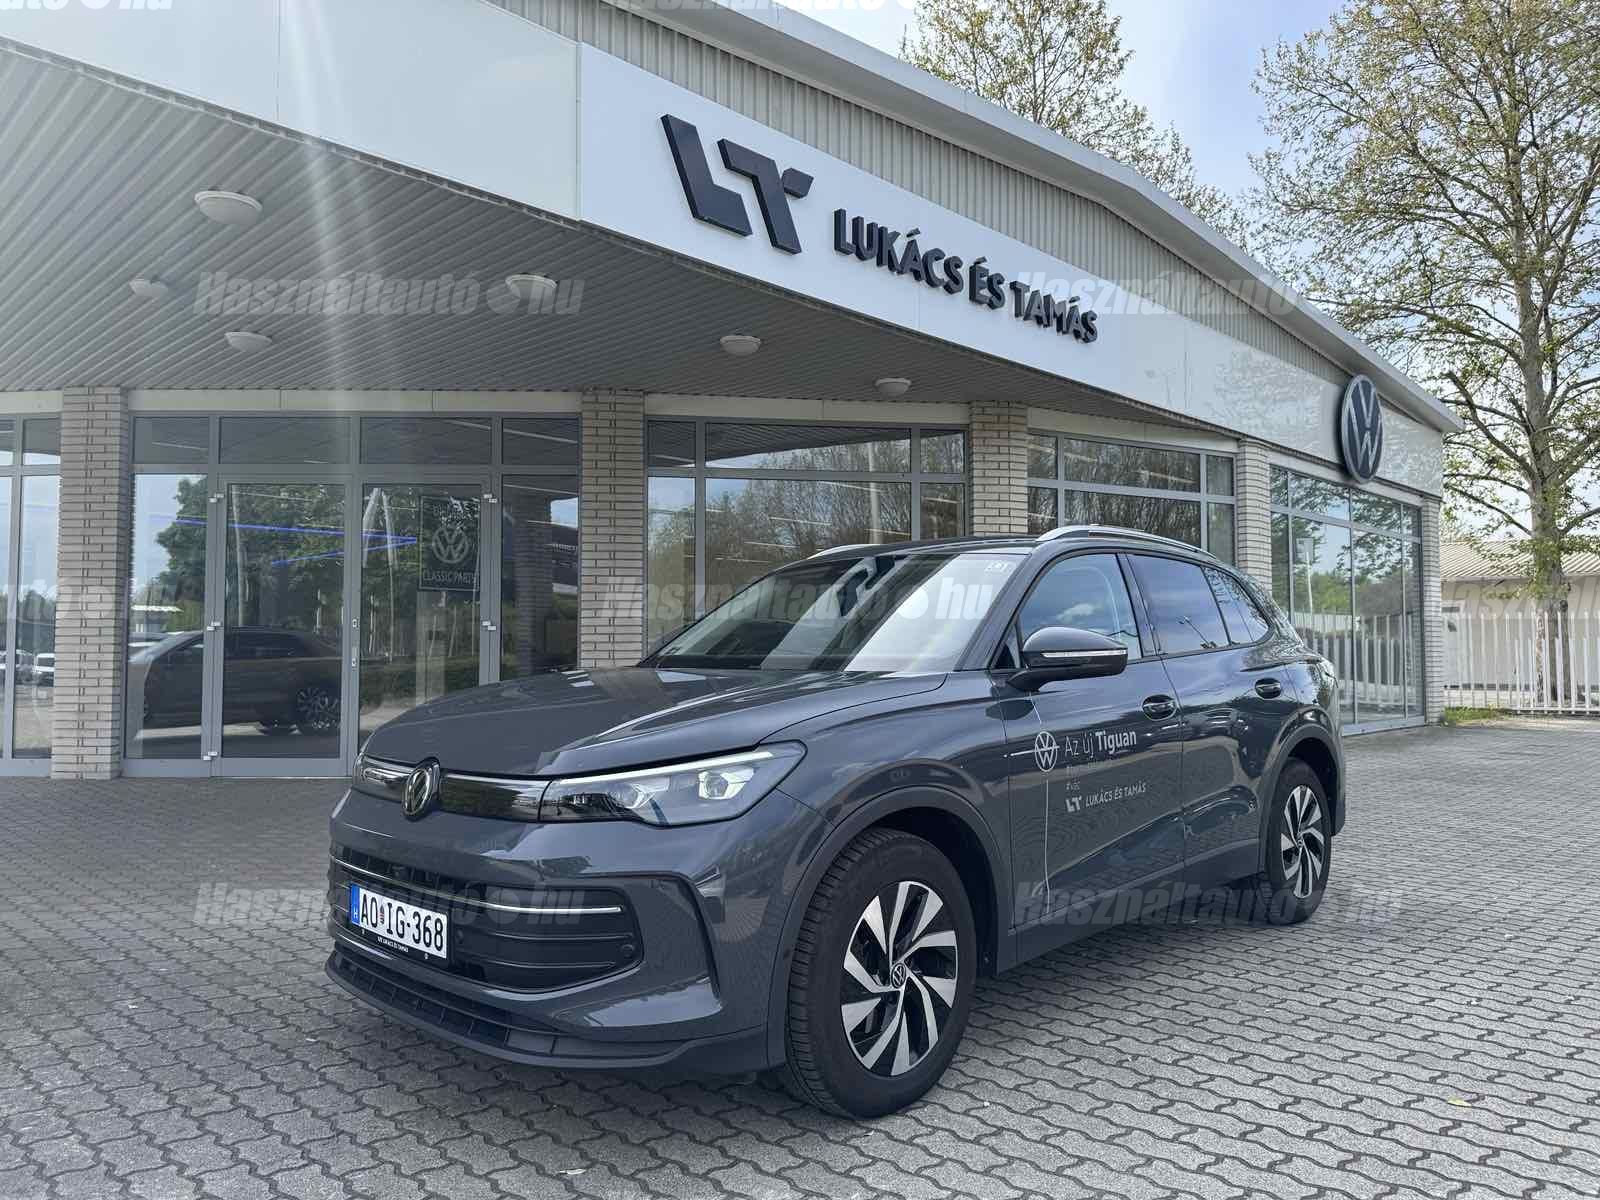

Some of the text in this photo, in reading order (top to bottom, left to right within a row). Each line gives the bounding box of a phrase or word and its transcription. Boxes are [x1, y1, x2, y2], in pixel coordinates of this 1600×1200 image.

[834, 208, 1098, 344] LUKÁCS ÉS TAMÁS
[1065, 730, 1137, 758] Az új Tiguan
[1085, 788, 1113, 808] LUKÁCS
[1114, 785, 1123, 800] ÉS
[1124, 780, 1147, 798] TAMÁS
